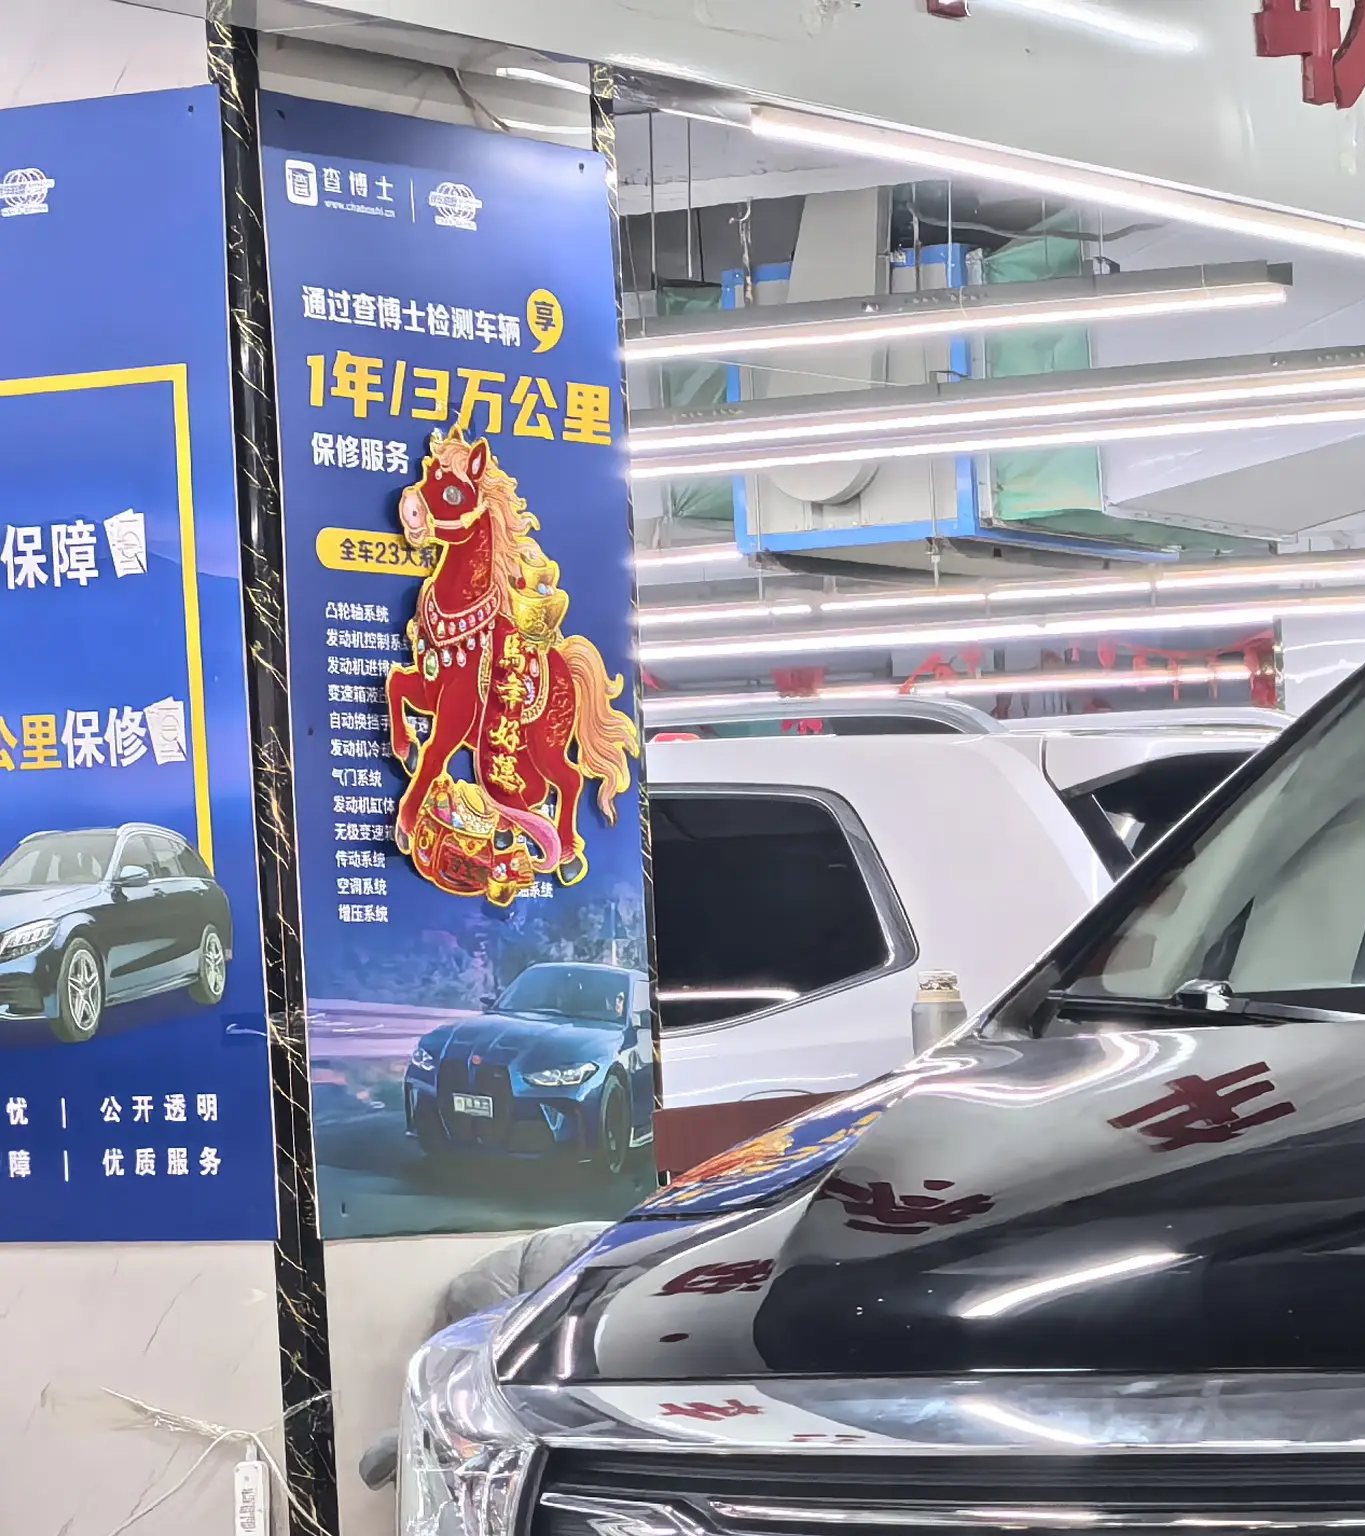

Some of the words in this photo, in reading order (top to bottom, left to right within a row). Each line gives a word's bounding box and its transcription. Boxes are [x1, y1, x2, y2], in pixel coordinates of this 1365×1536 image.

[322, 167, 395, 202] 查博士
[302, 285, 521, 347] 通过查博士检测车辆
[534, 300, 556, 332] 享
[306, 350, 613, 446] 1年/3万公里
[311, 431, 410, 475] 保修服务
[1, 519, 99, 590] 保障
[325, 602, 390, 623] 凸轮轴系统
[331, 768, 382, 787] 气门系统
[335, 850, 386, 869] 传动系统
[337, 877, 388, 896] 空调系统
[338, 904, 389, 923] 增压系统
[6, 1096, 29, 1125] 忧
[100, 1093, 218, 1123] 公开透明
[8, 1149, 31, 1178] 障
[102, 1146, 222, 1177] 优质服务
